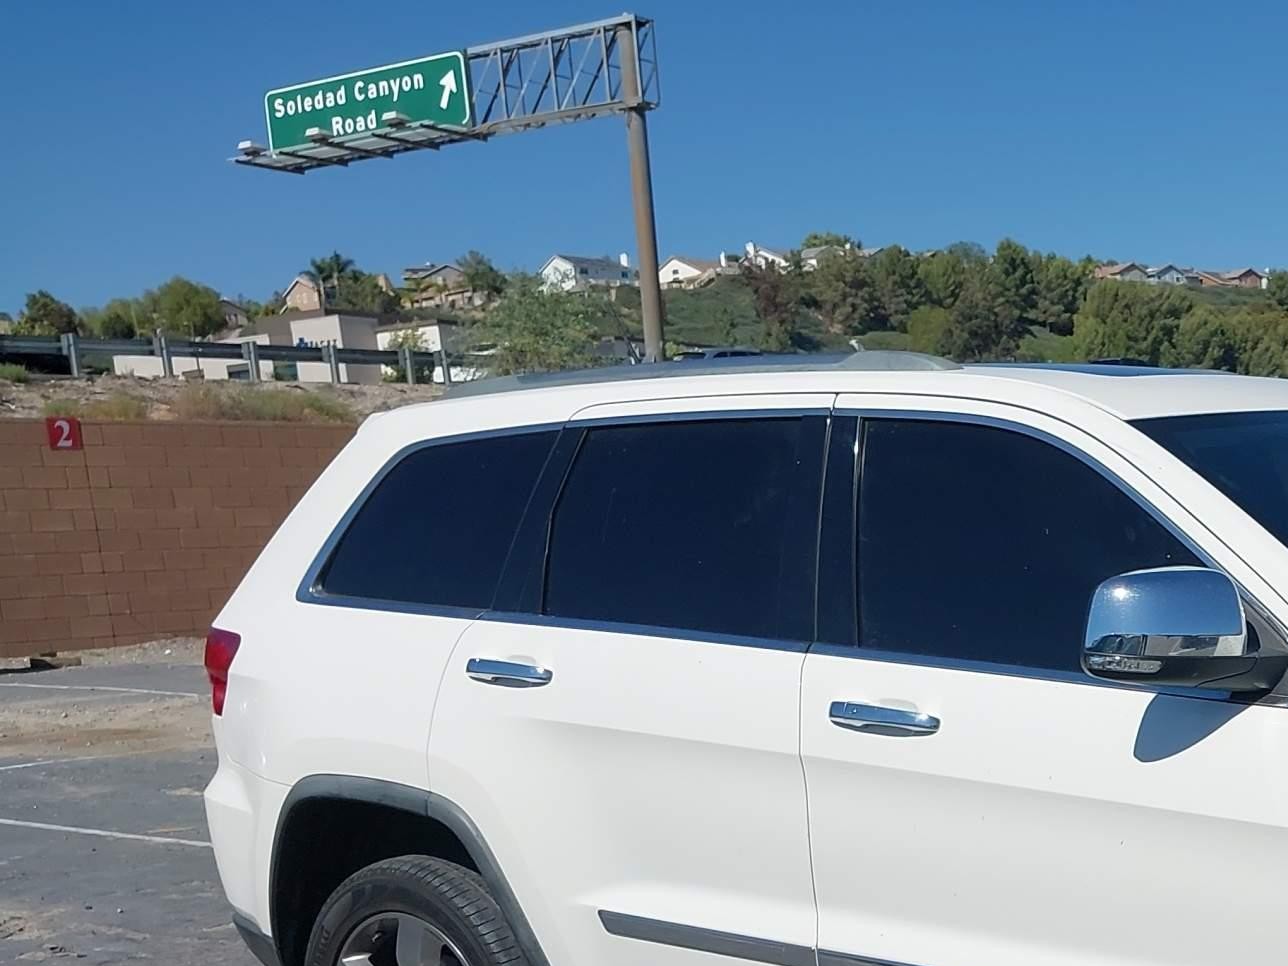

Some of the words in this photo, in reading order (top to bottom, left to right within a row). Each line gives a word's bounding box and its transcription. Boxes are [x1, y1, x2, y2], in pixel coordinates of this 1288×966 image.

[274, 85, 346, 118] Soledad
[354, 73, 424, 102] Canyon
[331, 109, 377, 136] Road
[54, 420, 73, 447] 2
